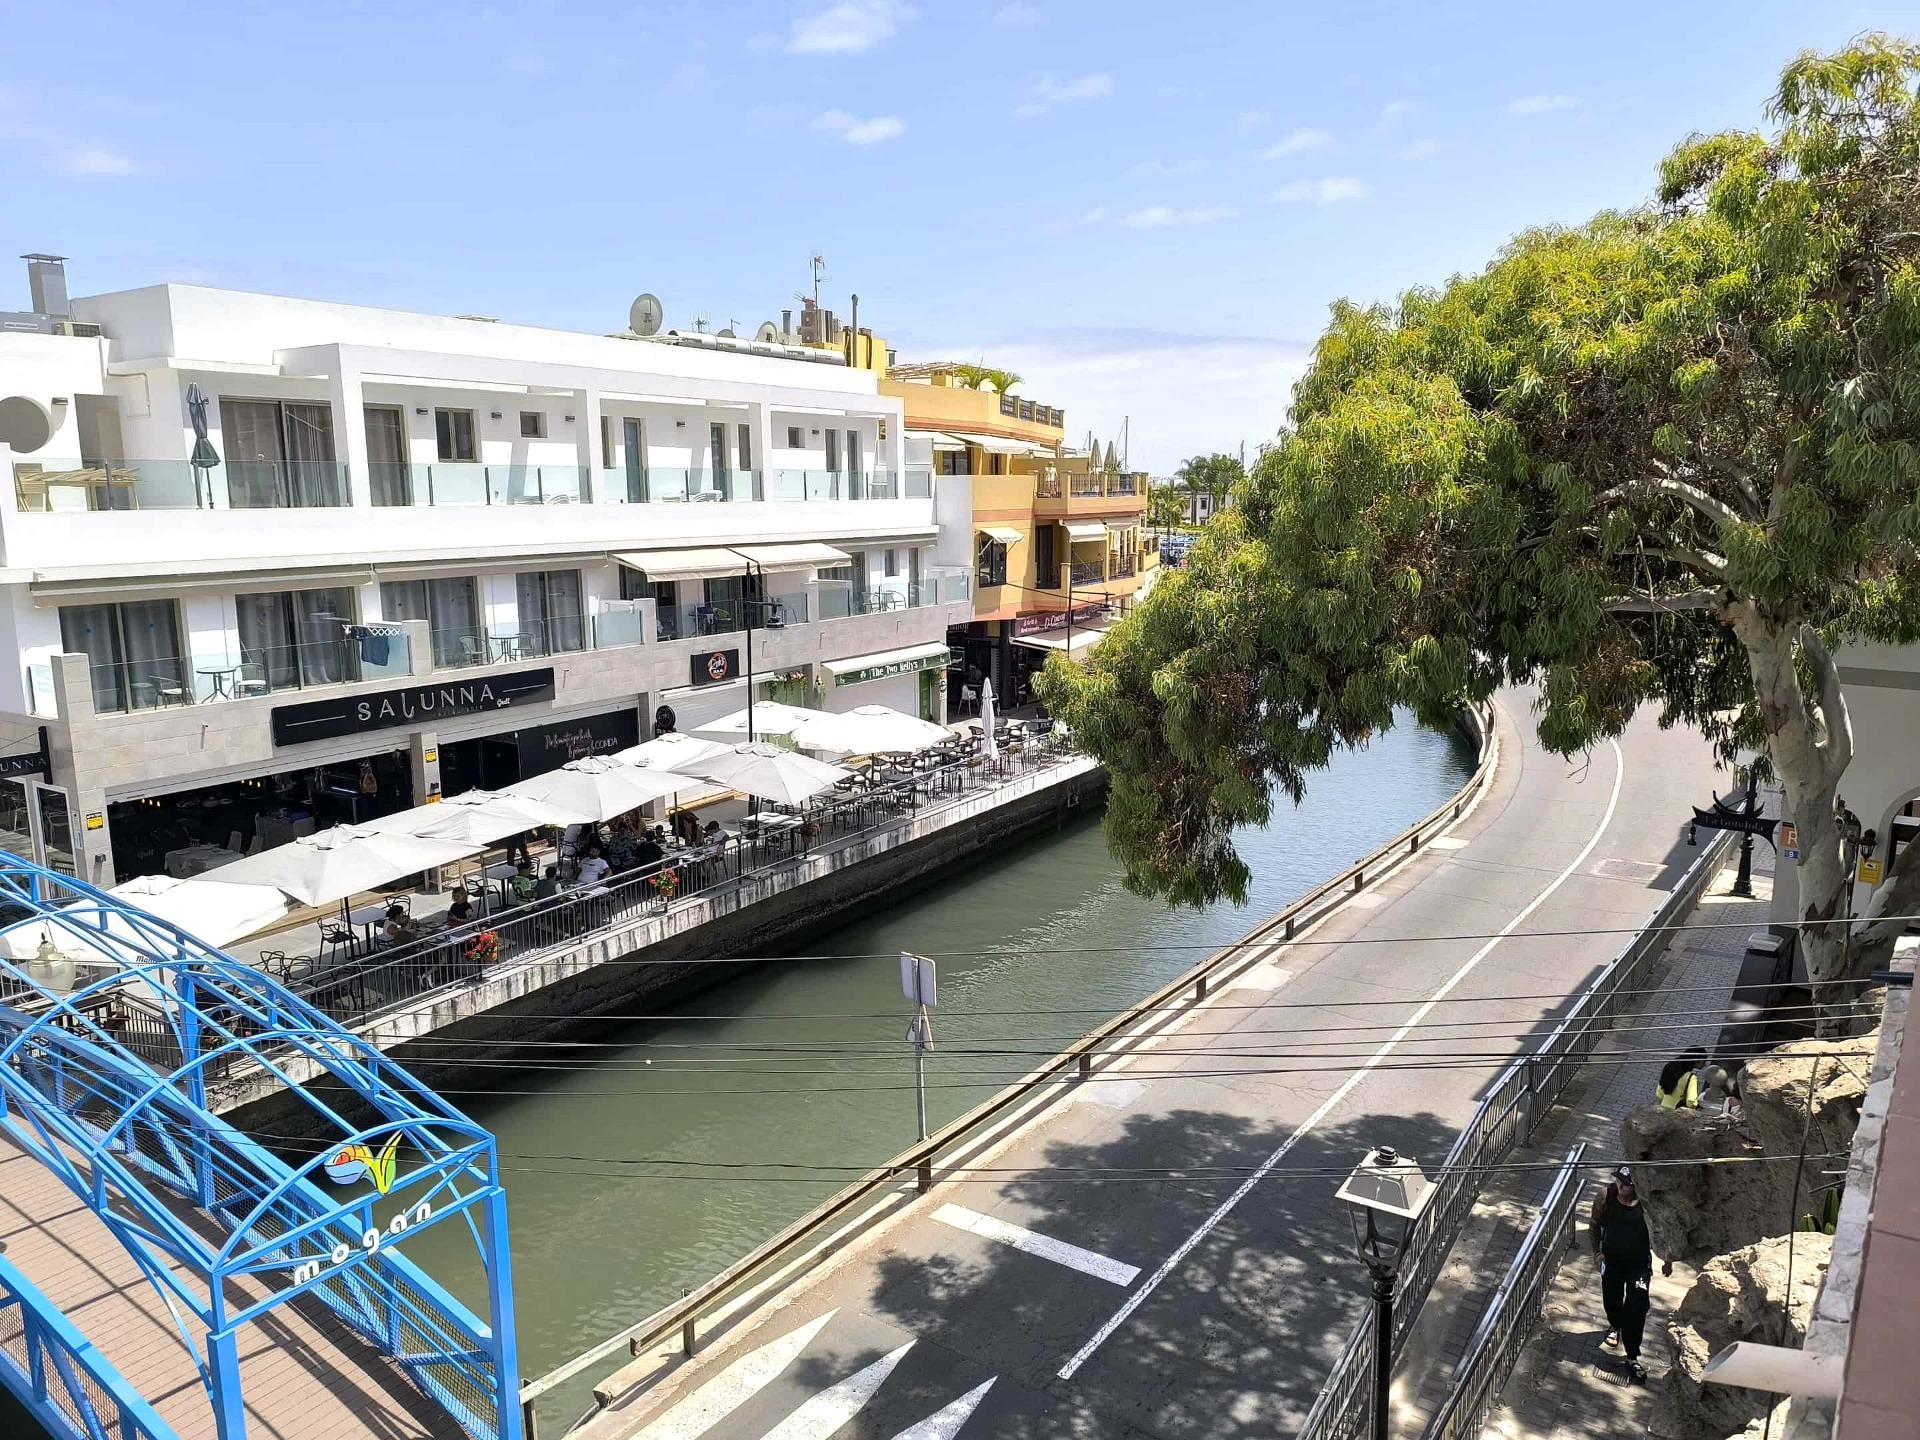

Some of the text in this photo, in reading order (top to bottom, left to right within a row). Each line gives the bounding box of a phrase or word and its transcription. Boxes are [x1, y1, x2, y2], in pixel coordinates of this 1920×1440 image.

[871, 661, 918, 678] The Two Kelly's
